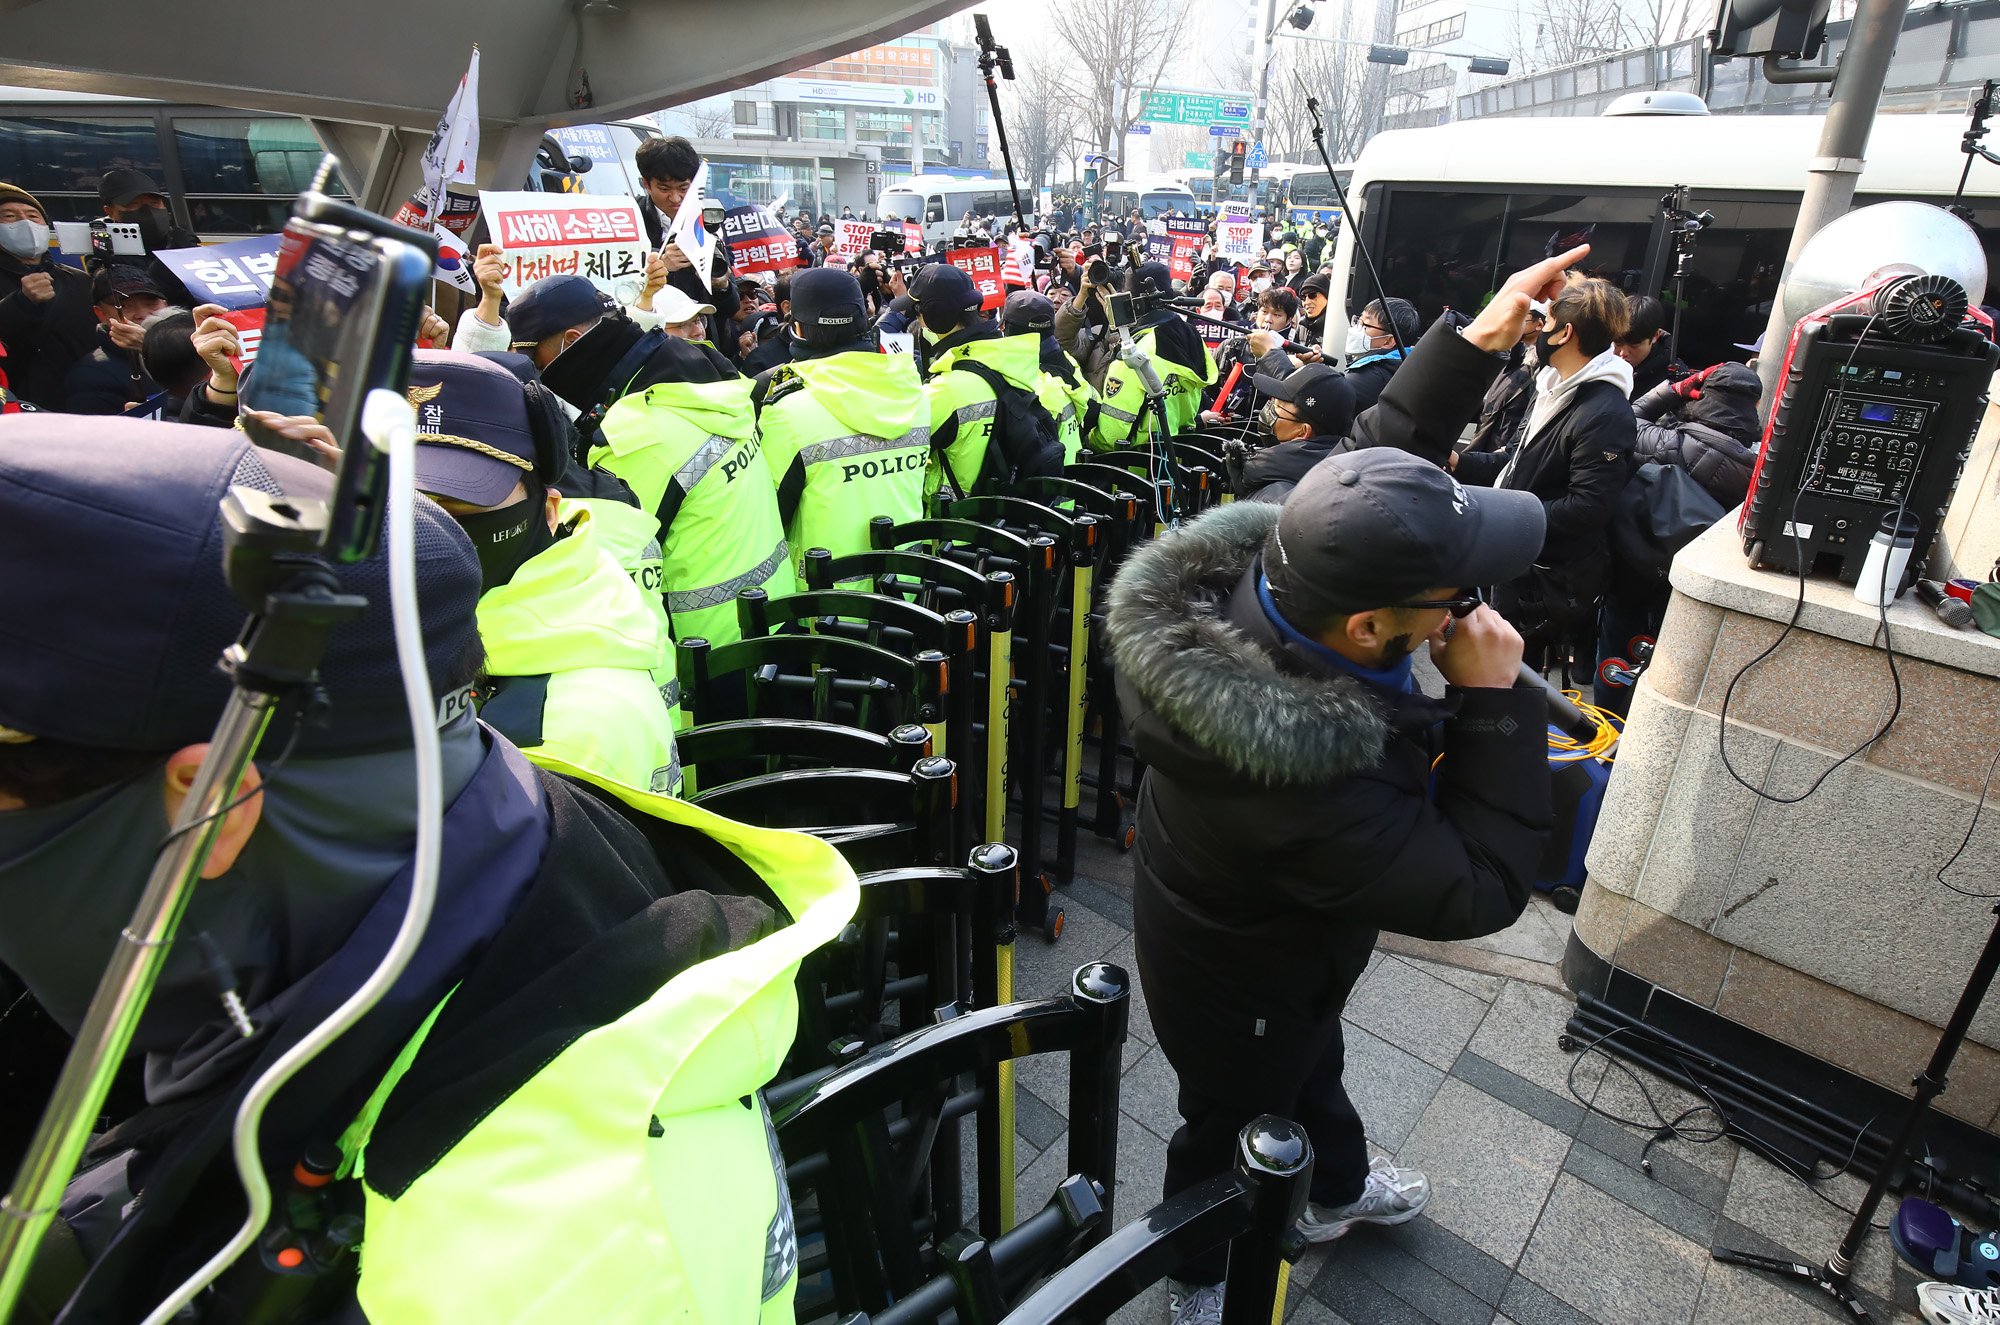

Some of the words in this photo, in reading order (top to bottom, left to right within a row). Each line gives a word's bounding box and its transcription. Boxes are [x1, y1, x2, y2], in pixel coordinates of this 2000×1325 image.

[918, 92, 936, 104] HD
[868, 162, 876, 171] 5
[505, 214, 563, 243] 새해
[564, 211, 637, 239] 소원은
[844, 223, 875, 237] STOP
[1228, 227, 1253, 237] STOP
[848, 234, 869, 245] THE
[1231, 236, 1248, 246] THE
[1149, 242, 1170, 257] 명분
[1224, 245, 1253, 255] STEAL
[584, 249, 647, 282] 체포!
[953, 254, 996, 276] 탄핵
[974, 279, 1000, 297] 효
[424, 404, 444, 426] 찰
[842, 450, 928, 483] POLICE
